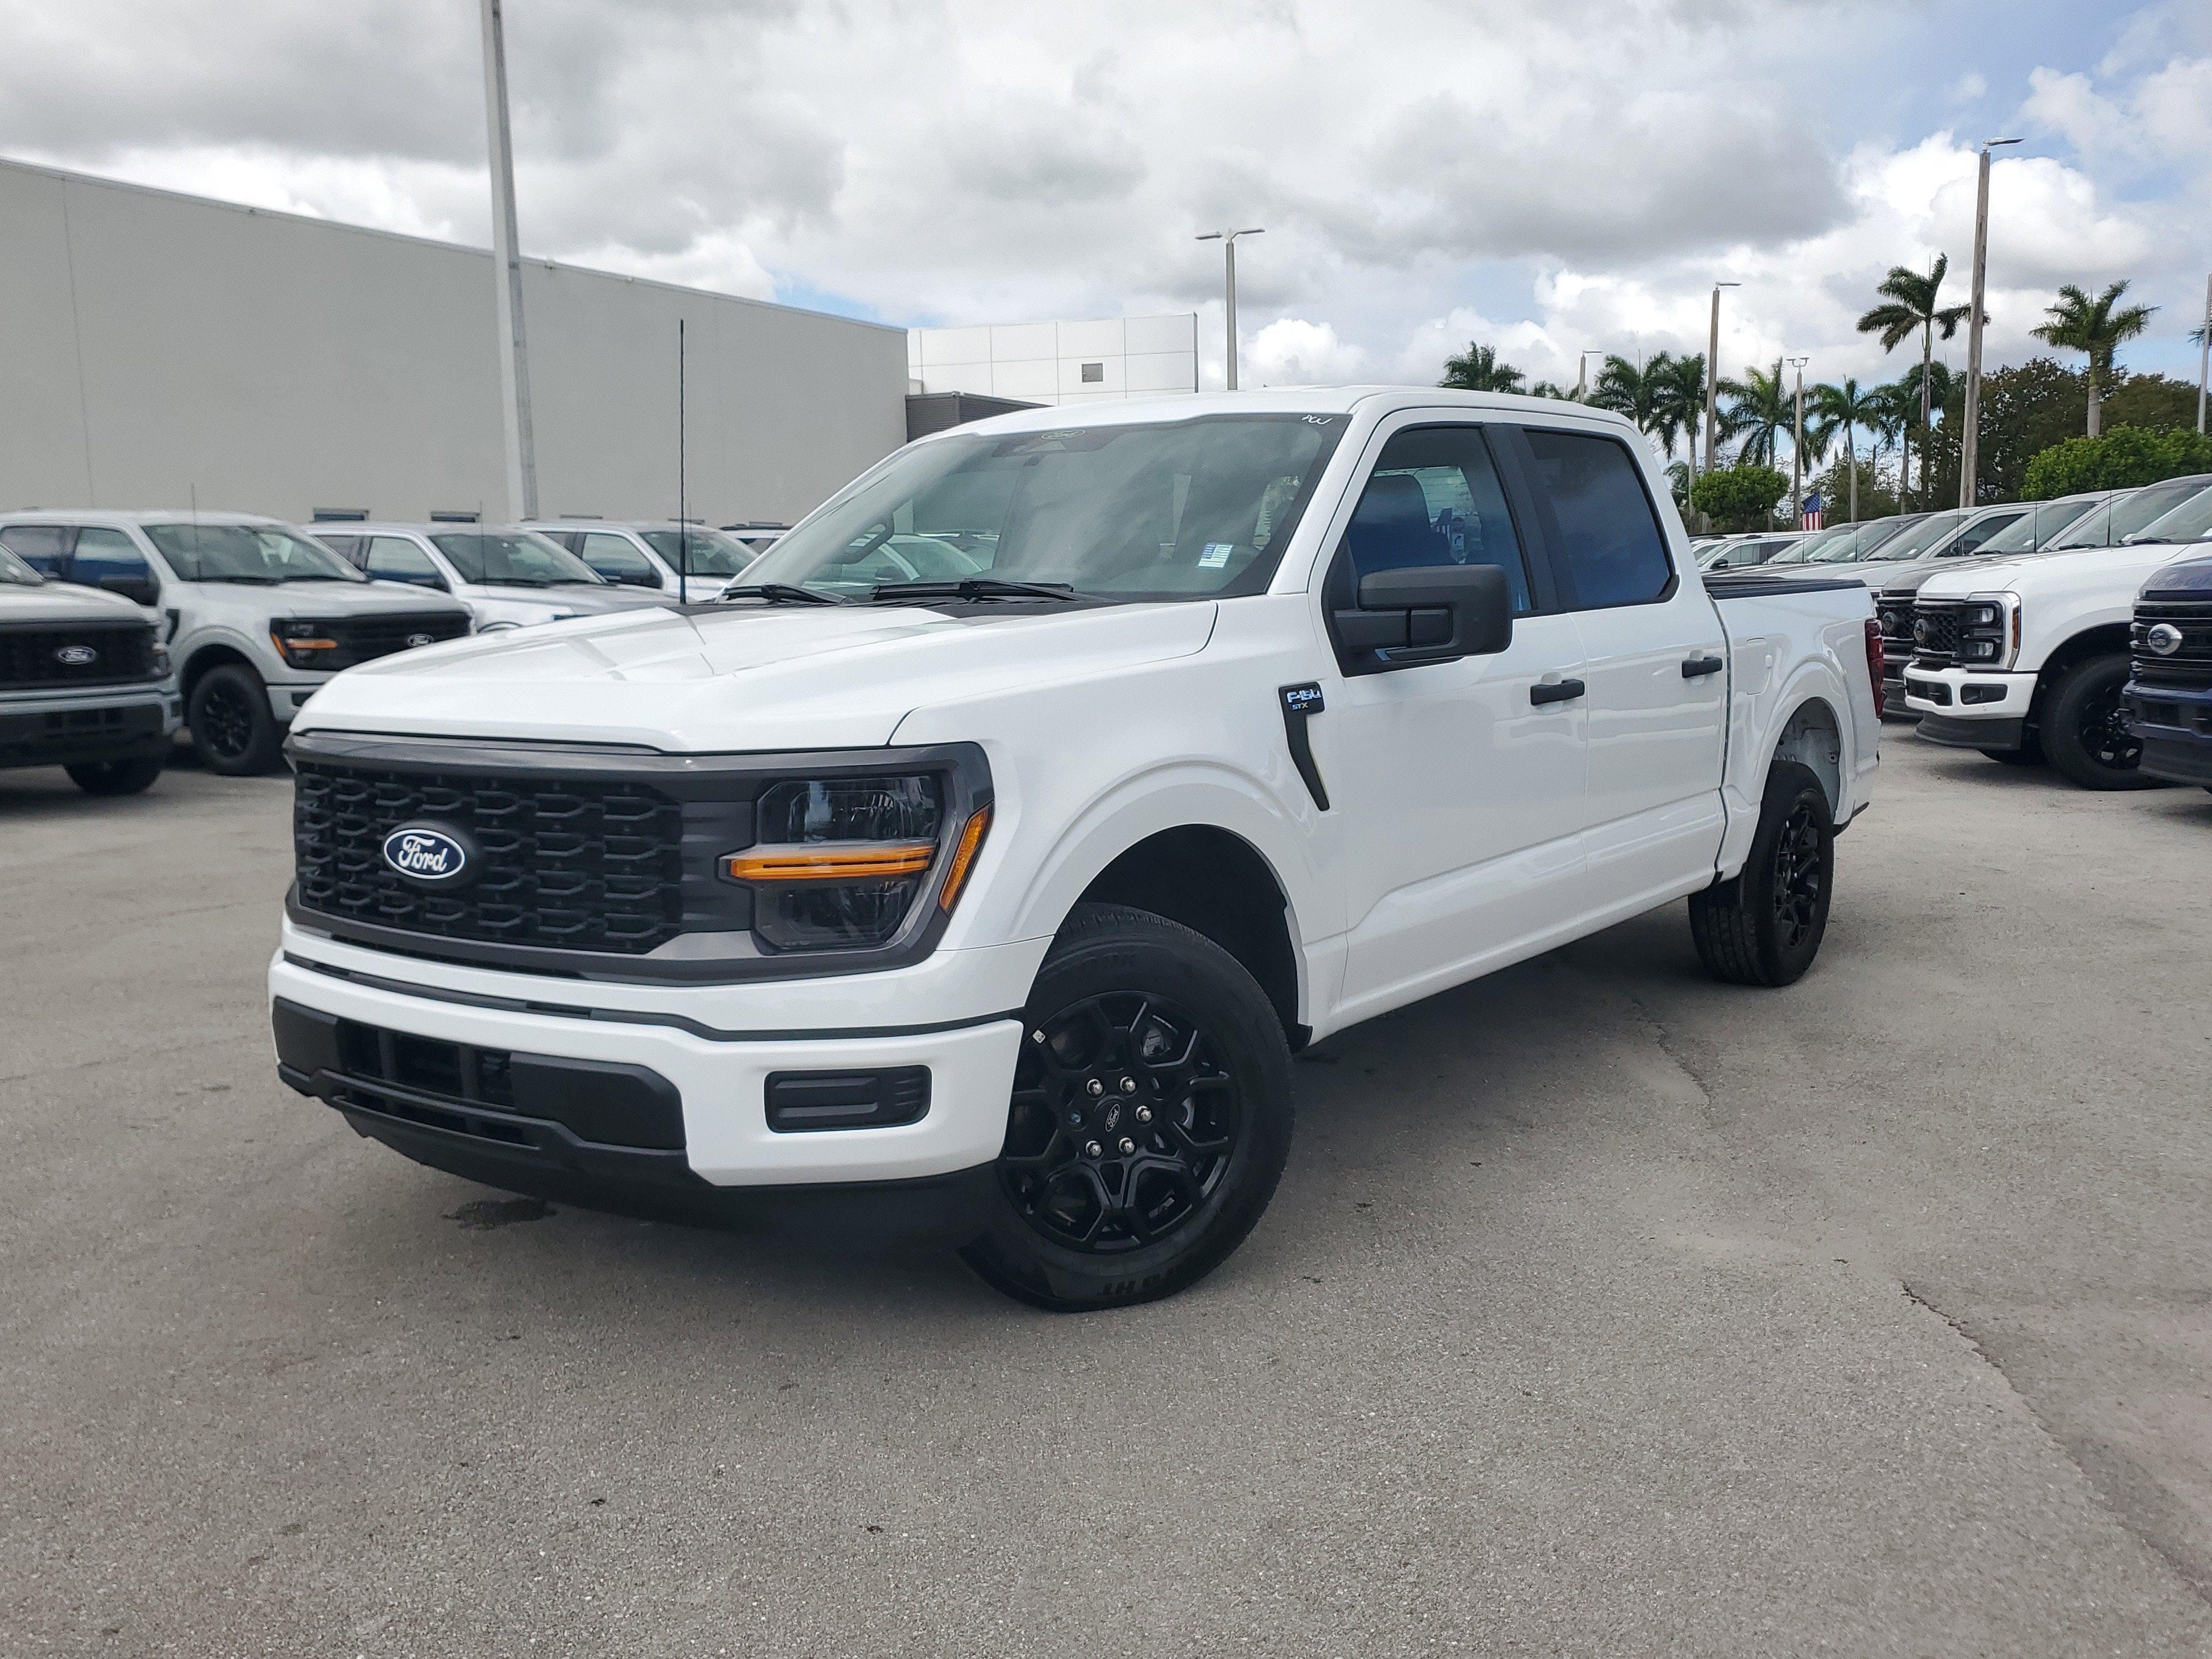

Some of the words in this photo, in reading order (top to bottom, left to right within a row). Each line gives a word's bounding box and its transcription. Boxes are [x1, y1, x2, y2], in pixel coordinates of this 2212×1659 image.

[1291, 702, 1309, 710] STX
[398, 834, 448, 872] Ford
[1108, 1108, 1119, 1127] Ford
